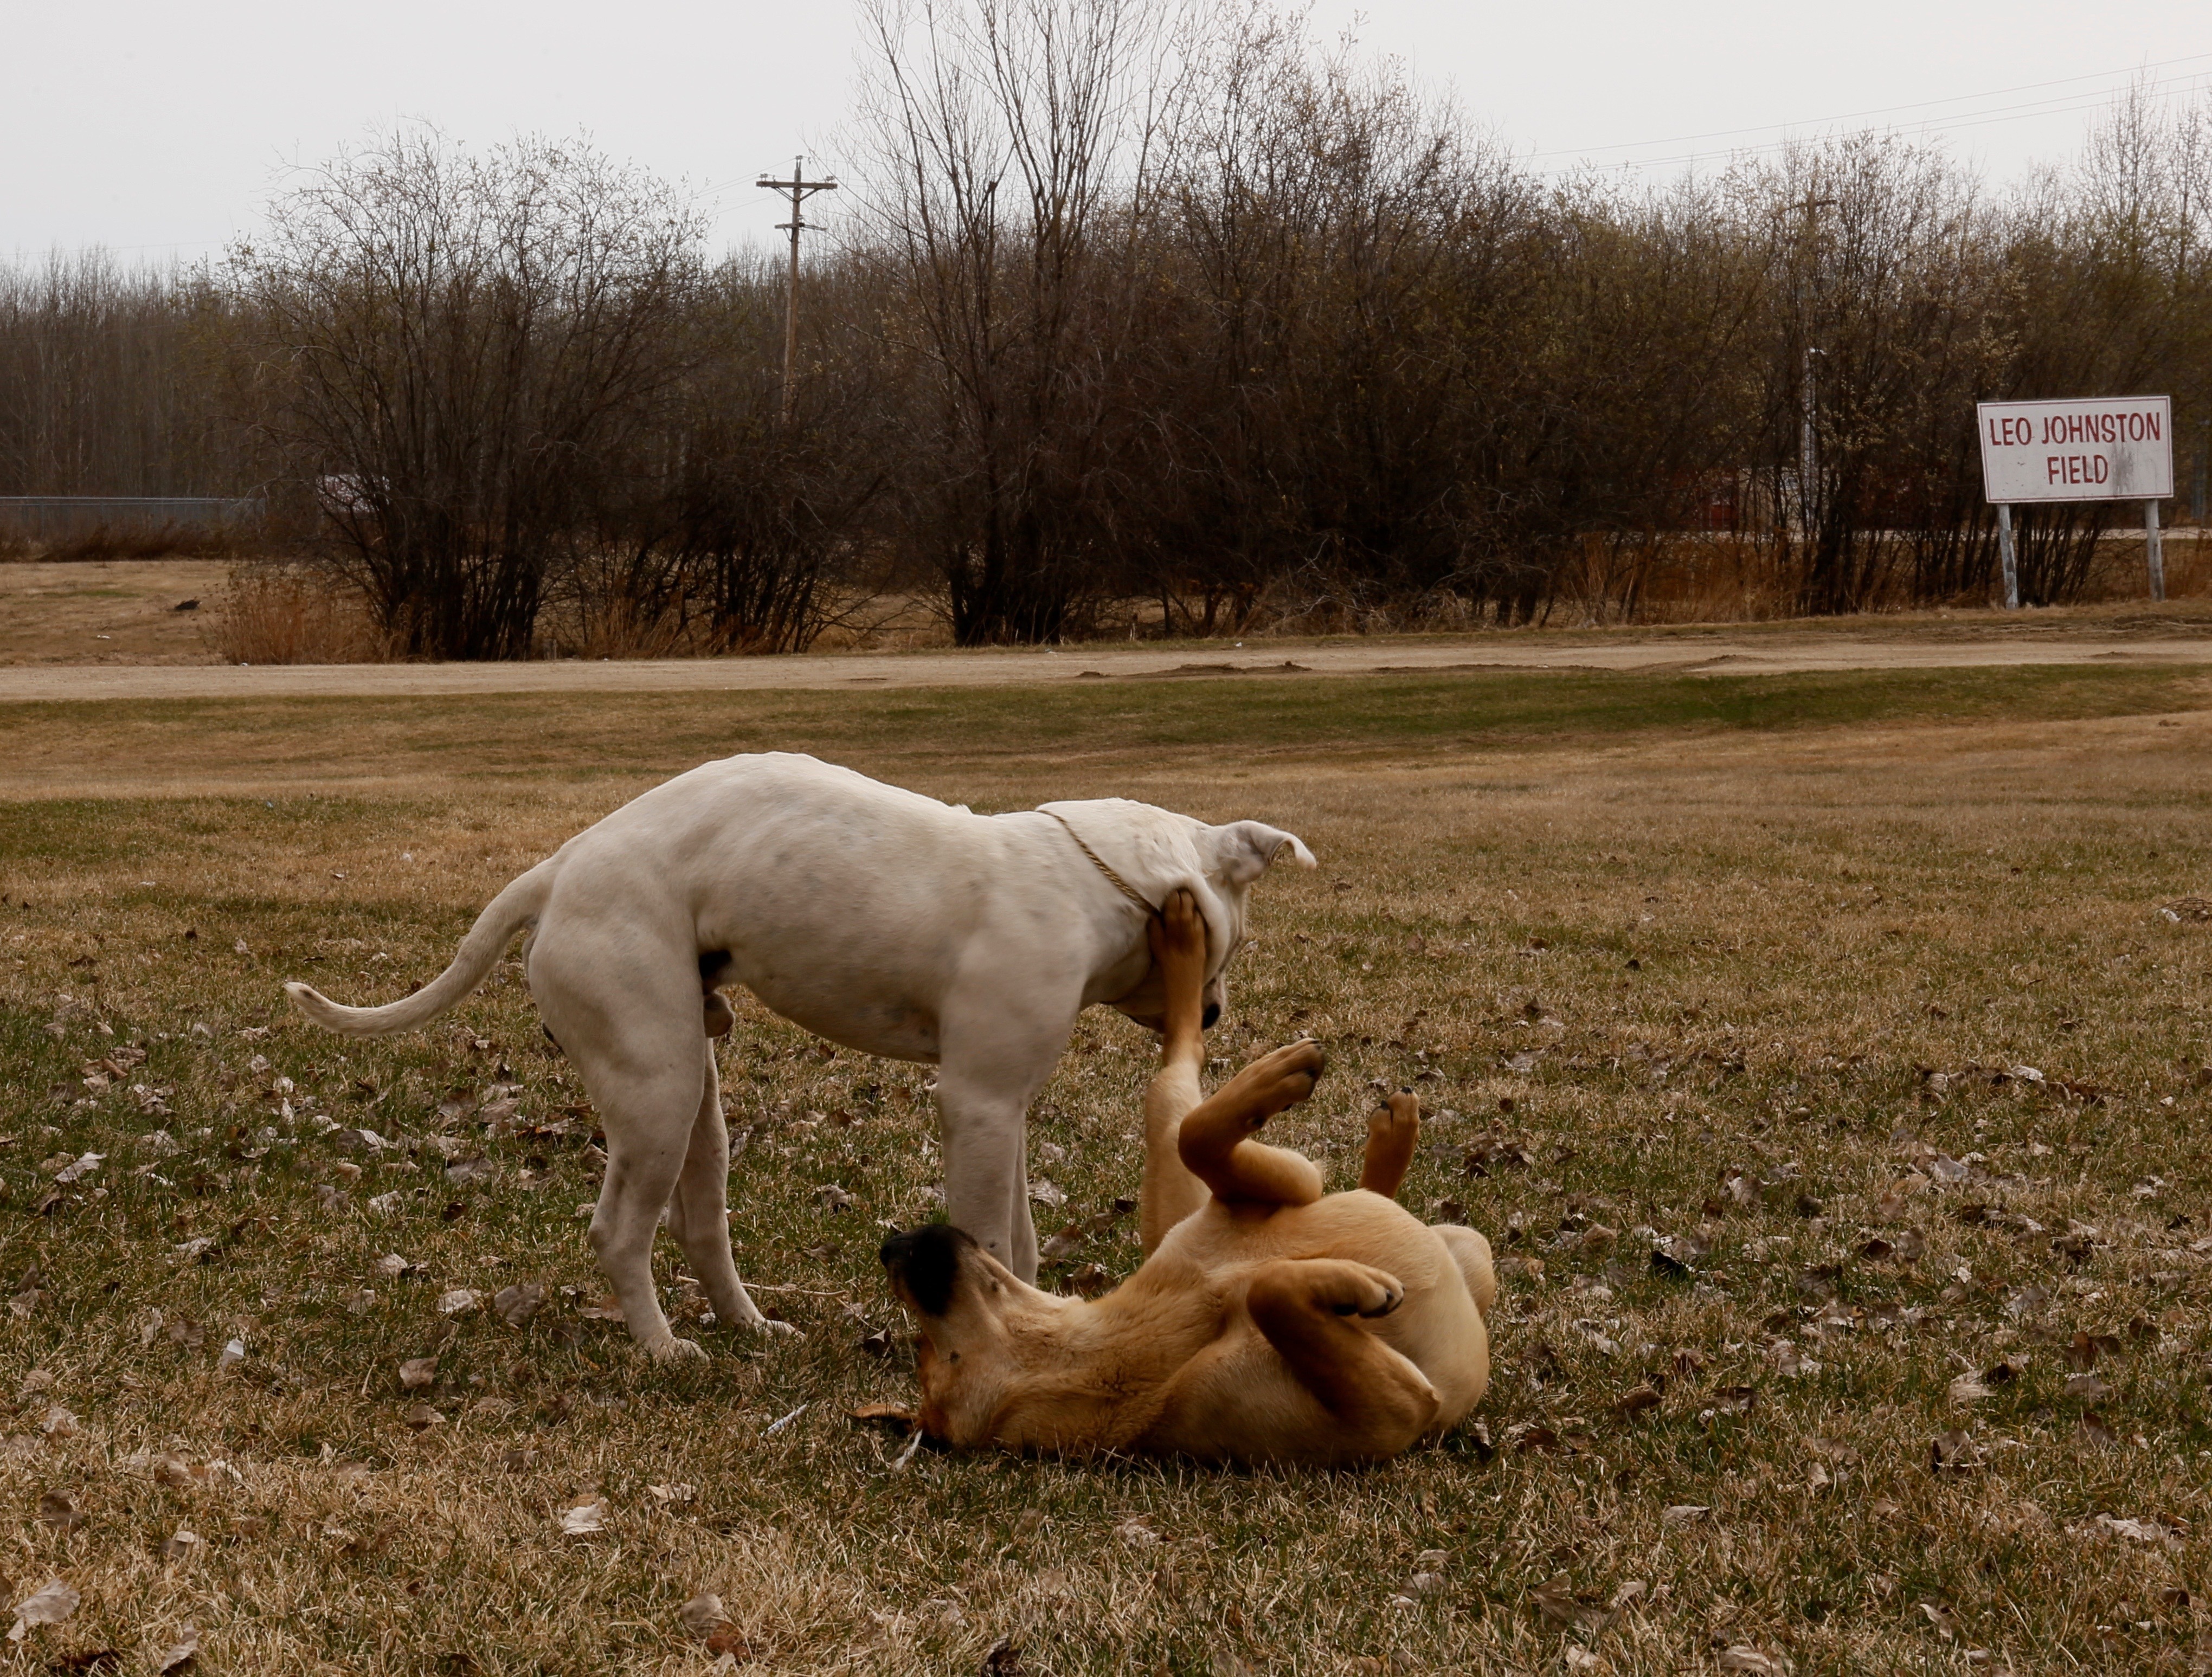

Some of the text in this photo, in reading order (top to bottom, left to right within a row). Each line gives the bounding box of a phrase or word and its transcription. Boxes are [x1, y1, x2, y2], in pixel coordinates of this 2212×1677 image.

[1990, 412, 2160, 446] LEO JOHNSTON
[2047, 454, 2108, 485] FIELD
